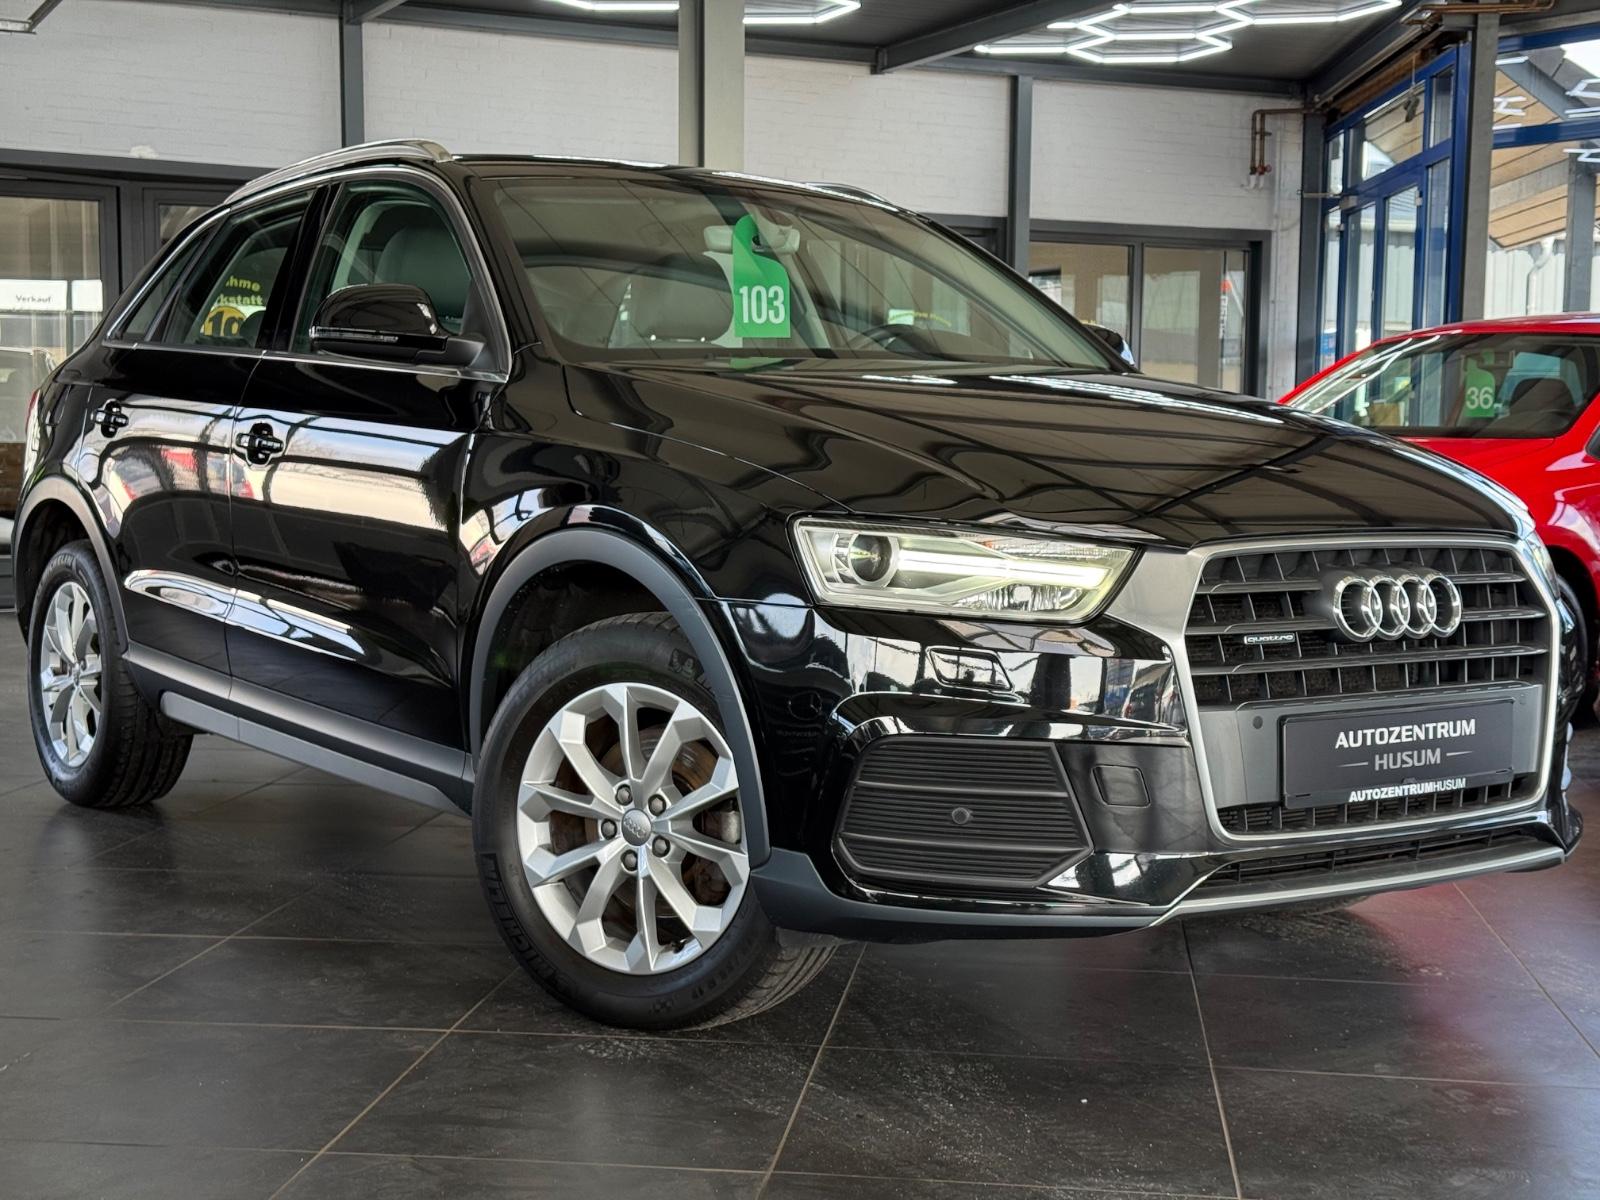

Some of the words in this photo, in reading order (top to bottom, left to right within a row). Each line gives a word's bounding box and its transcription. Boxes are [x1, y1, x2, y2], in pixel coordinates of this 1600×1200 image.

[15, 294, 52, 303] Verkauf
[739, 284, 786, 324] 103
[1466, 386, 1494, 409] 36
[1247, 634, 1294, 644] quattro
[1335, 719, 1476, 749] AUTOZENTRUM
[1374, 748, 1441, 771] HUSUM
